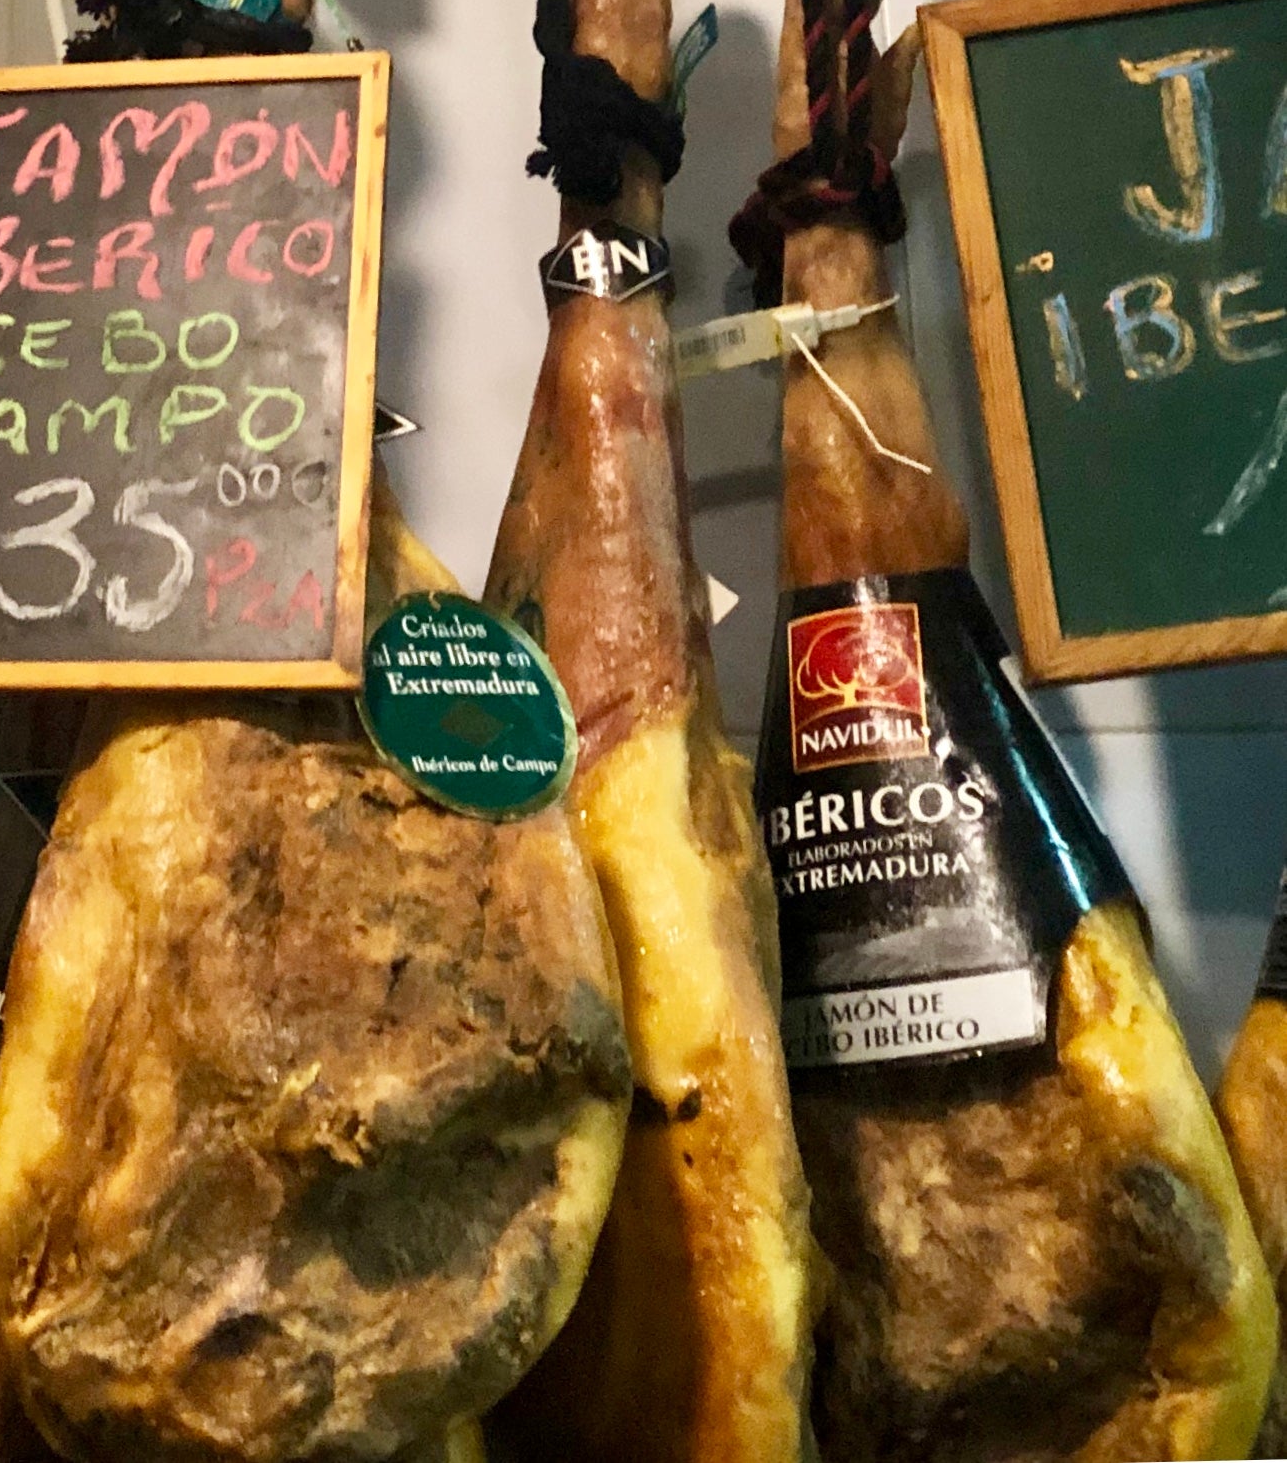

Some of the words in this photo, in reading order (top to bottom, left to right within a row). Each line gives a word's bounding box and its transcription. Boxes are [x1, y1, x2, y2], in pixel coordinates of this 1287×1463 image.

[401, 614, 488, 639] Criados
[373, 643, 390, 667] al
[397, 645, 443, 666] aire
[446, 642, 501, 667] libre
[506, 650, 531, 668] en
[386, 671, 540, 696] Extremadura
[411, 754, 477, 775] Ibéricos
[480, 753, 499, 774] de
[502, 754, 557, 776] Campo
[759, 780, 986, 848] BÉRICOS
[788, 835, 905, 868] ELABORADOS
[779, 851, 971, 897] XTREMADURA
[908, 991, 945, 1018] DE
[864, 1015, 981, 1051] IBÉRICO
